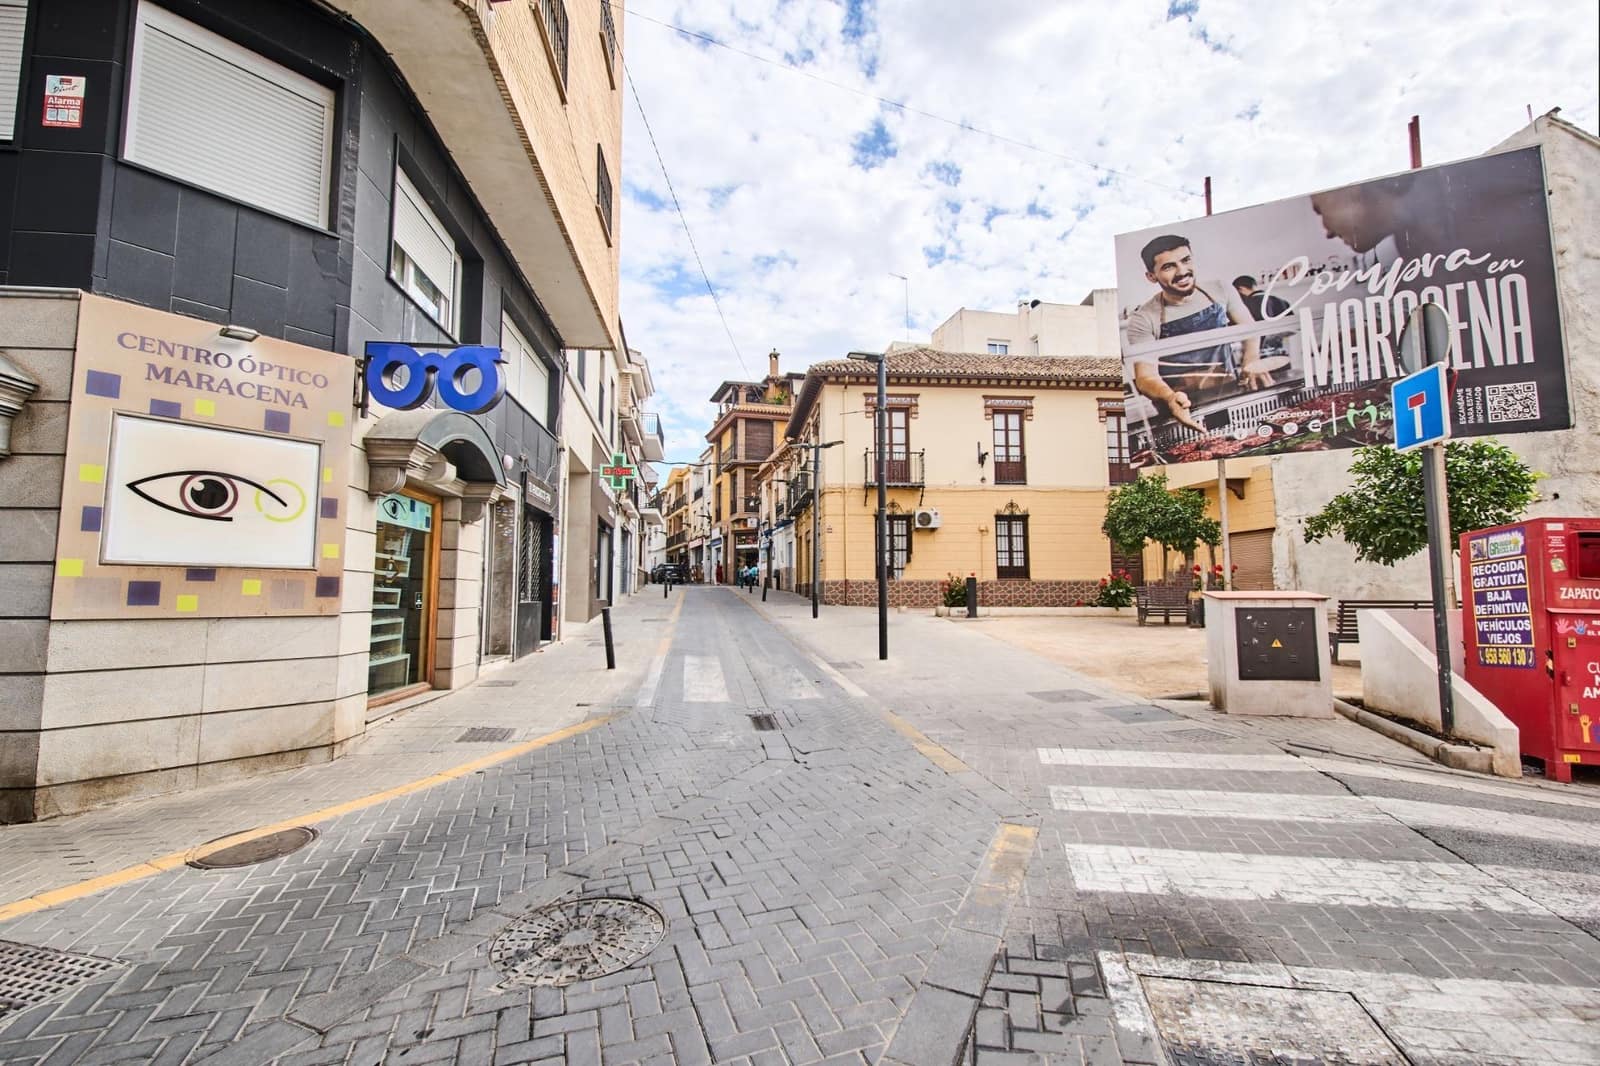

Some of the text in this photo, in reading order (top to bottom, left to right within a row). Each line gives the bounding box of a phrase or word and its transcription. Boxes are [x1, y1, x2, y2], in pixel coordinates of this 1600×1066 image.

[48, 96, 81, 106] Alarma
[1487, 257, 1524, 274] en
[1260, 248, 1491, 321] Compra
[1299, 273, 1535, 388] MARENA
[117, 332, 329, 389] CENTRO ÓPTICO
[144, 362, 309, 409] MARACENA
[1465, 387, 1475, 424] PARA ESTAR
[1474, 386, 1485, 423] INFORMADO
[1472, 560, 1525, 577] RECOGIDA
[1474, 573, 1526, 588] GRATUITA
[1486, 590, 1512, 602] BAJA
[1475, 602, 1529, 615] DEFINITIVA
[1477, 618, 1531, 632] VEHÍCULOS
[1487, 633, 1522, 644] VIEJOS
